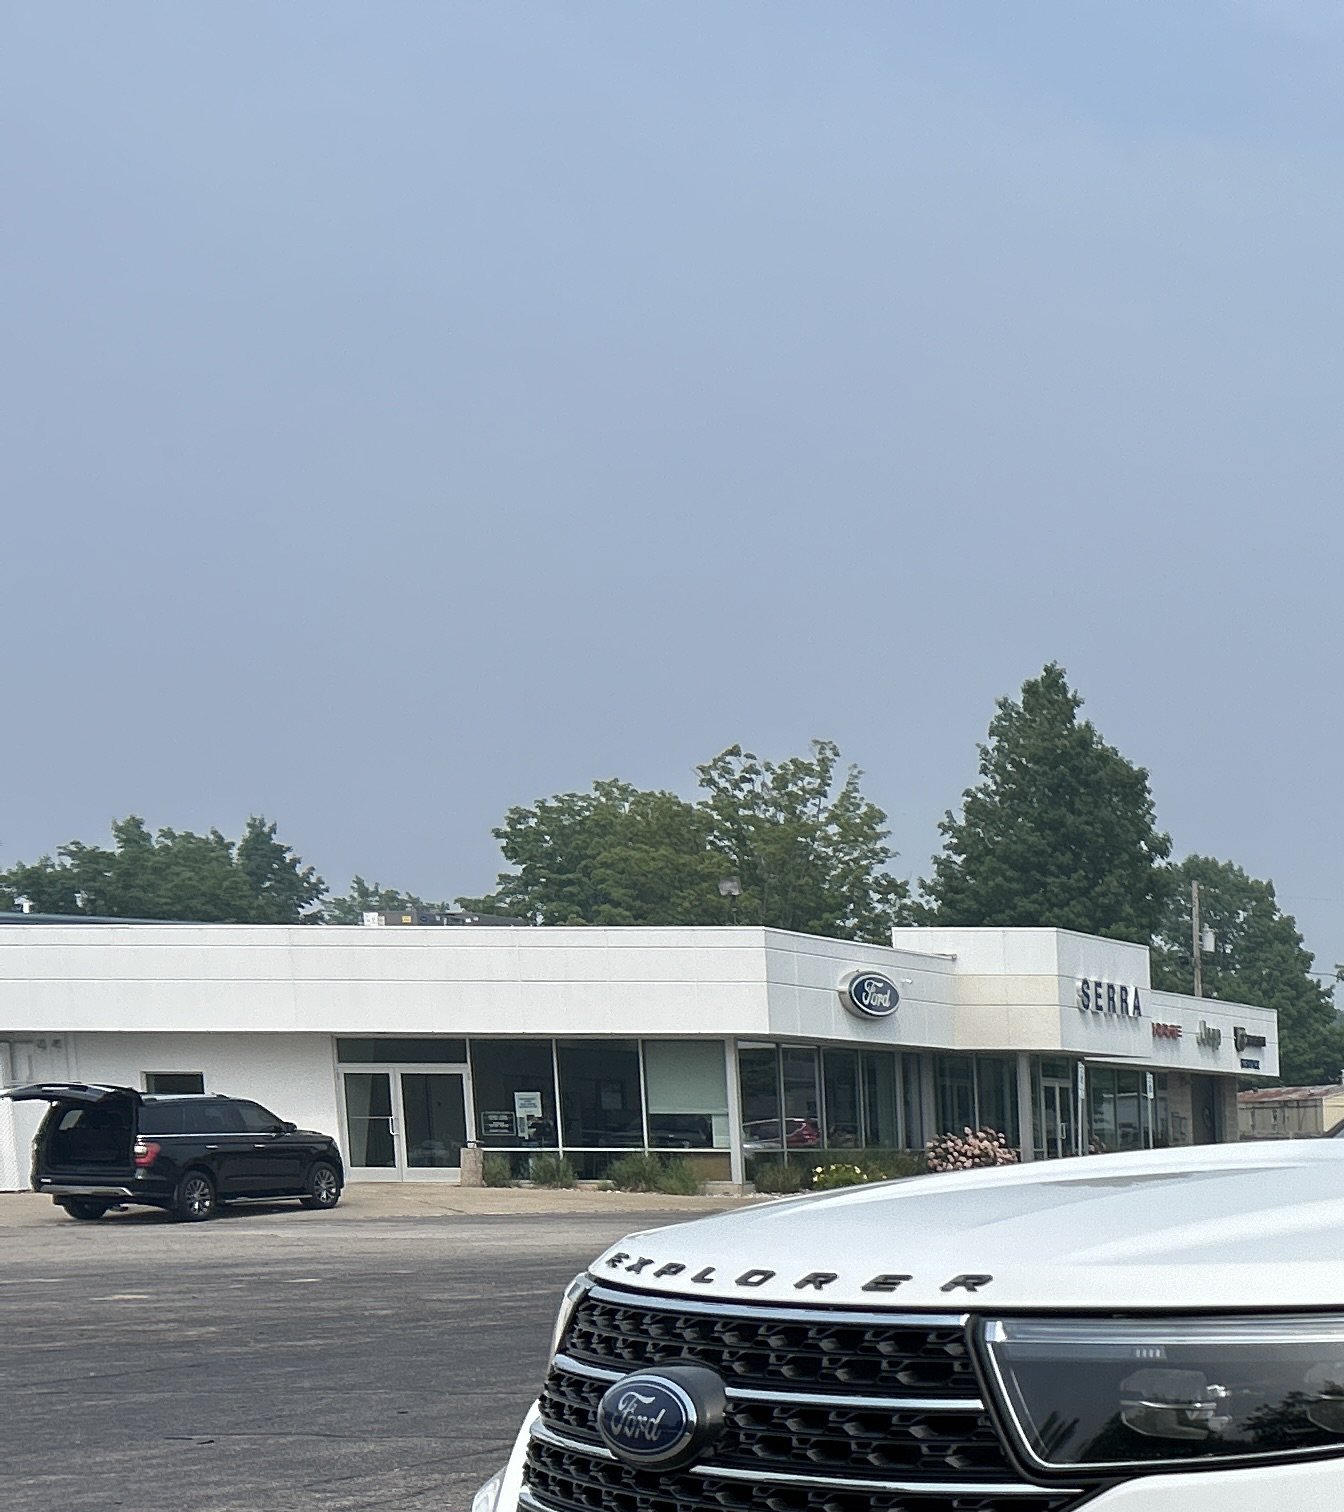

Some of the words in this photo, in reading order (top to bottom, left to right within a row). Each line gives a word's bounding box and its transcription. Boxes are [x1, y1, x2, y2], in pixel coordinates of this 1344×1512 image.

[862, 979, 891, 1008] Ford
[1080, 978, 1142, 1017] SERRA
[605, 1252, 993, 1293] EXPLORER
[610, 1391, 667, 1441] Ford
